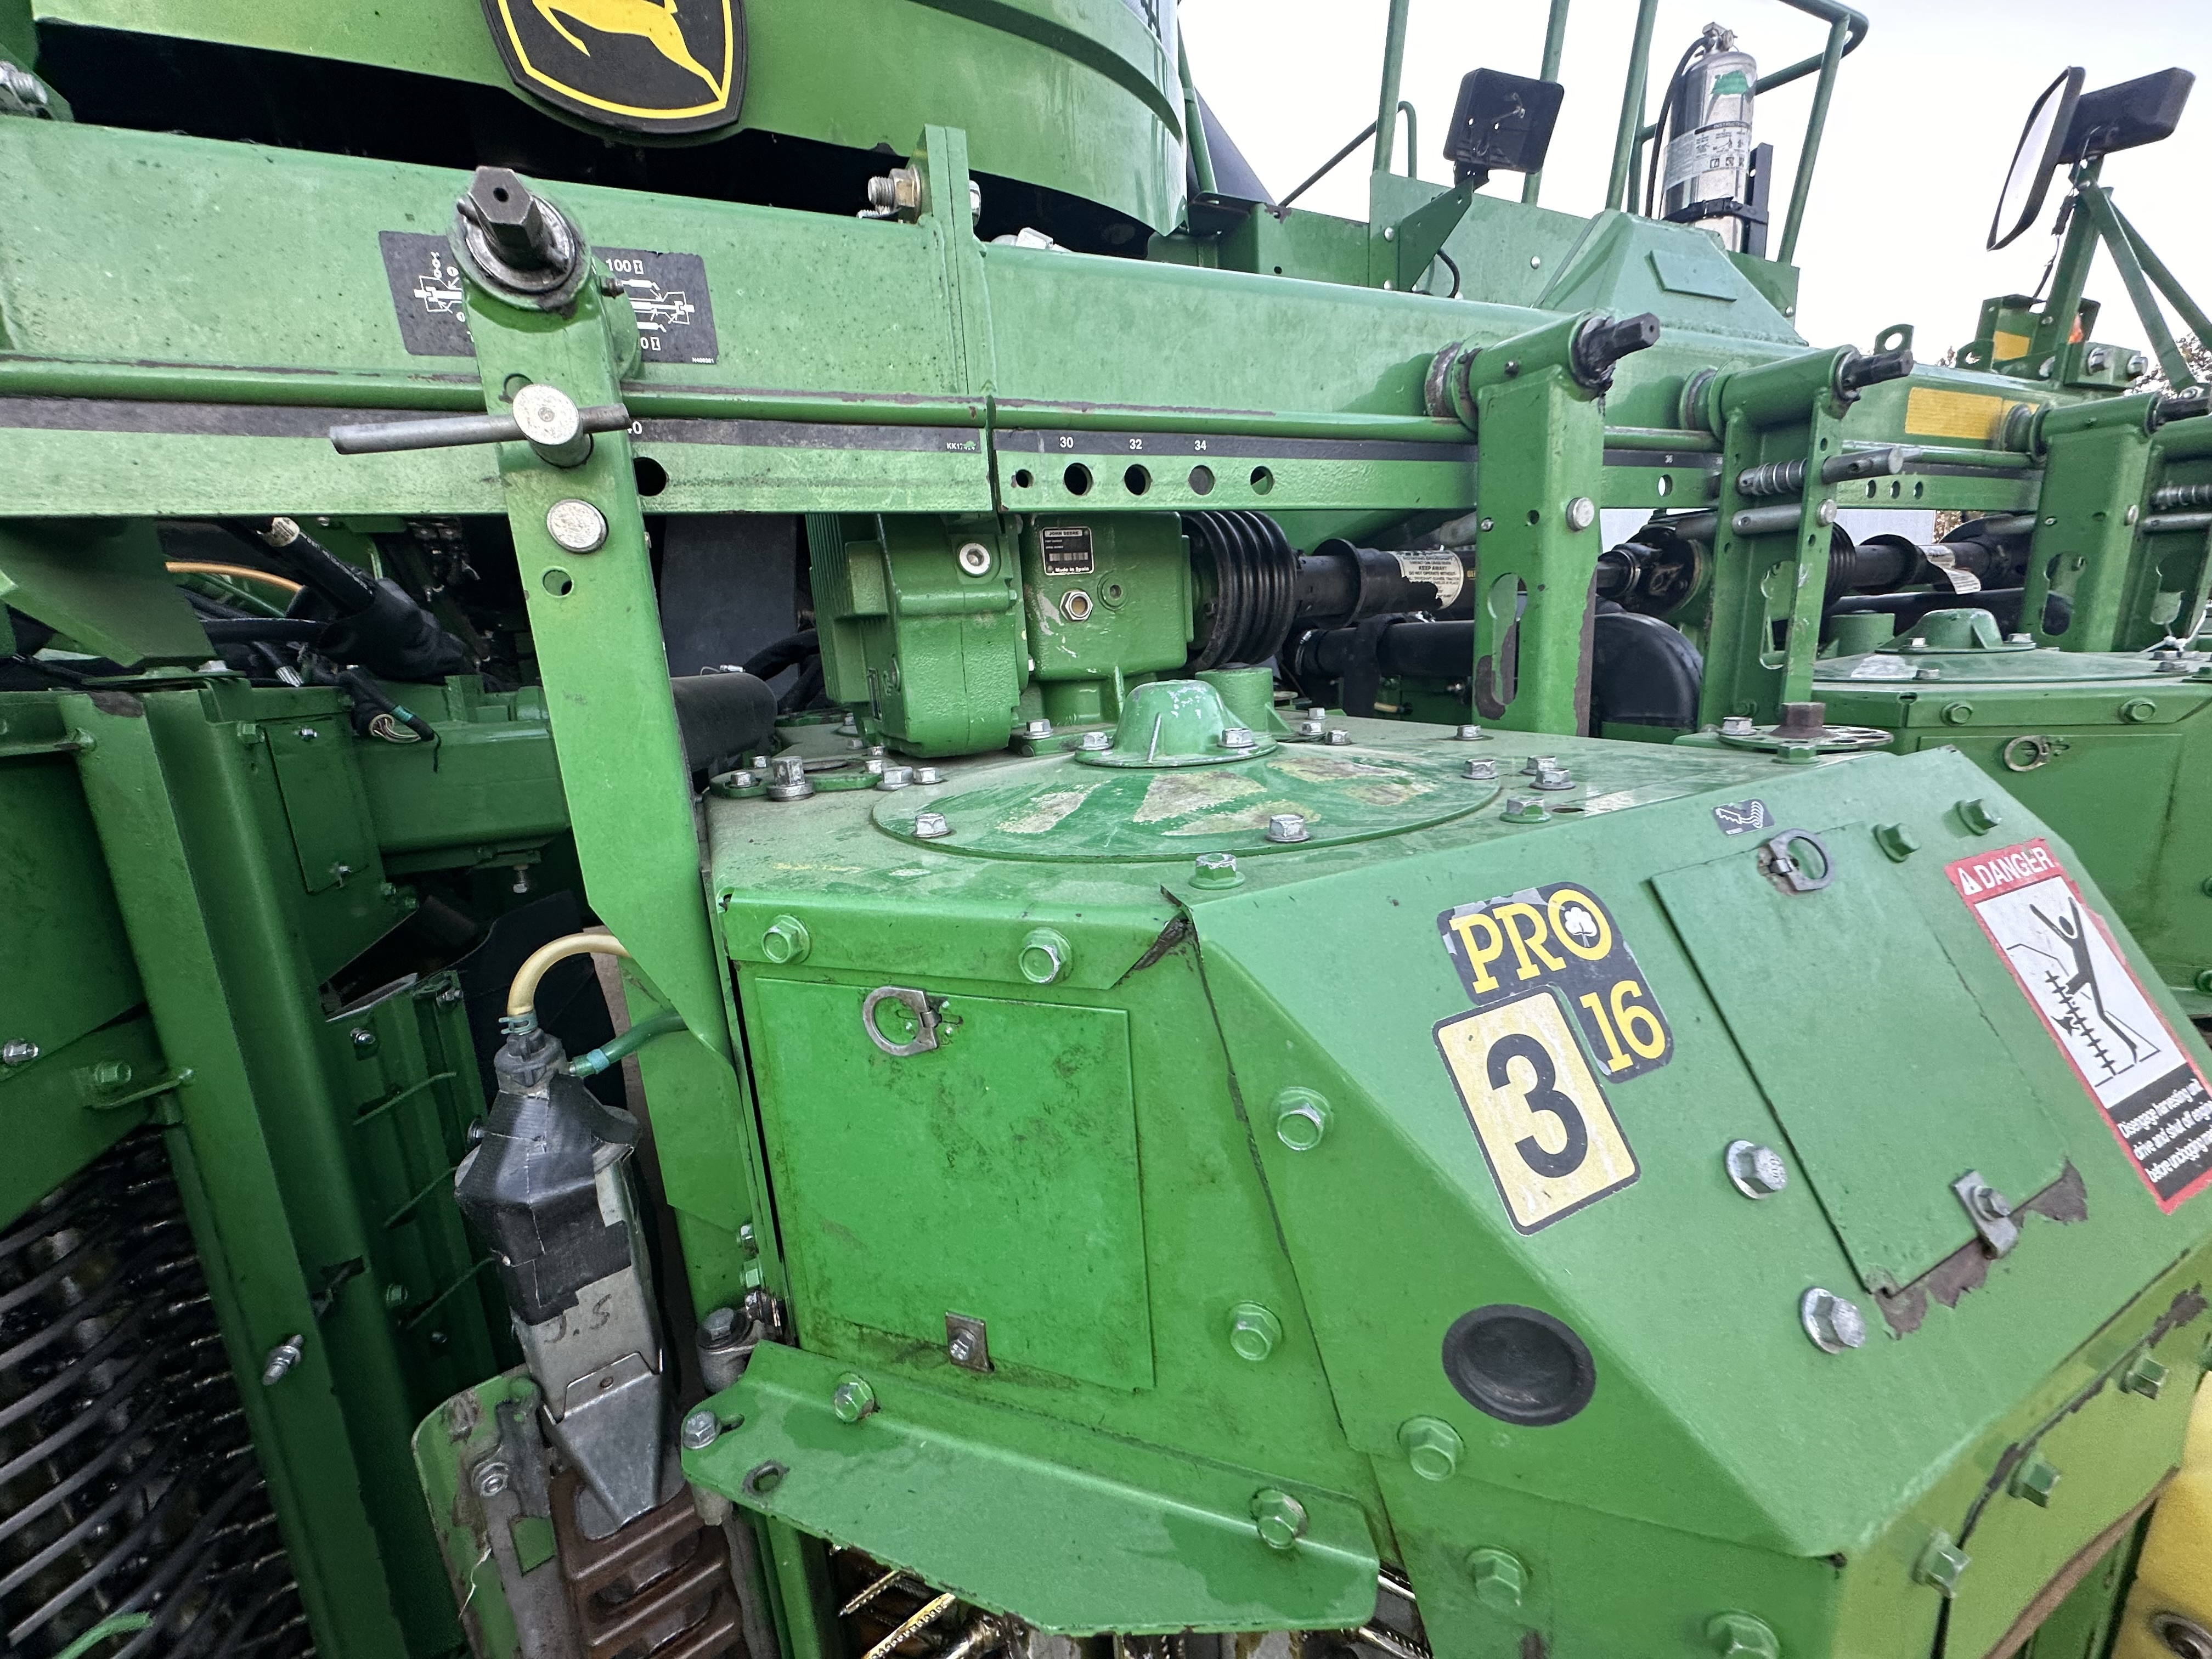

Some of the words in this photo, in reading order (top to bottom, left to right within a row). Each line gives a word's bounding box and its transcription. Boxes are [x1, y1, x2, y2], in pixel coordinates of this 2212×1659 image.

[605, 258, 631, 273] 100
[1059, 436, 1074, 448] 30
[1128, 438, 1143, 450] 32
[1194, 440, 1207, 450] 34
[1972, 847, 2056, 889] DANGER
[1448, 889, 1612, 994] PRO
[1579, 979, 1666, 1073] 16
[1486, 1033, 1588, 1178] 3
